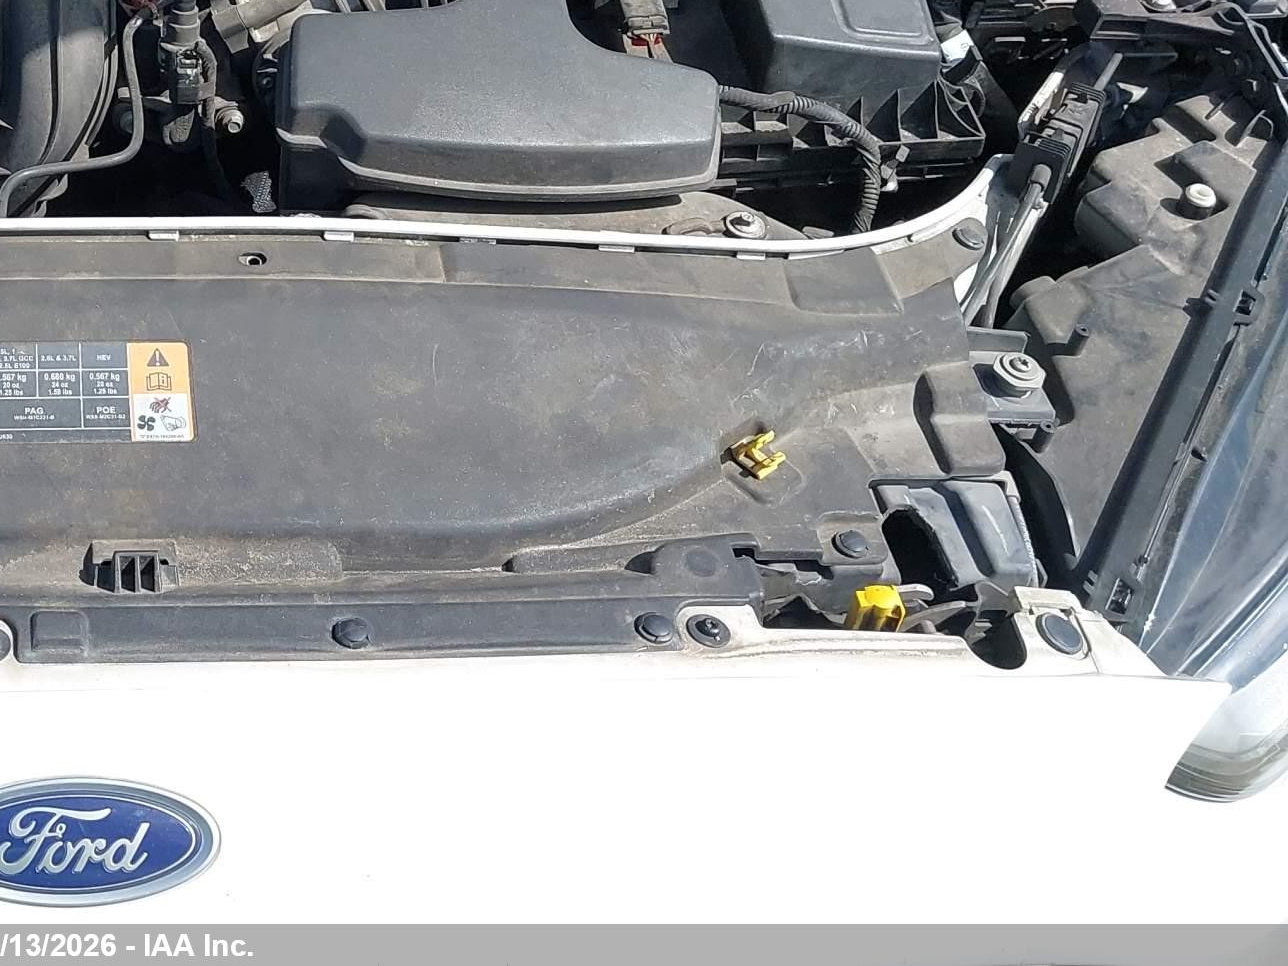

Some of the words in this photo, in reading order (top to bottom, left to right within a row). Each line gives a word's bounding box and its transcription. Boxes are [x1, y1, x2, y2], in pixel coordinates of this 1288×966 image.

[17, 373, 27, 383] kg
[65, 373, 75, 382] kg
[89, 372, 108, 380] 0.567
[110, 373, 120, 382] kg
[24, 407, 44, 415] PAG
[96, 406, 116, 414] POE
